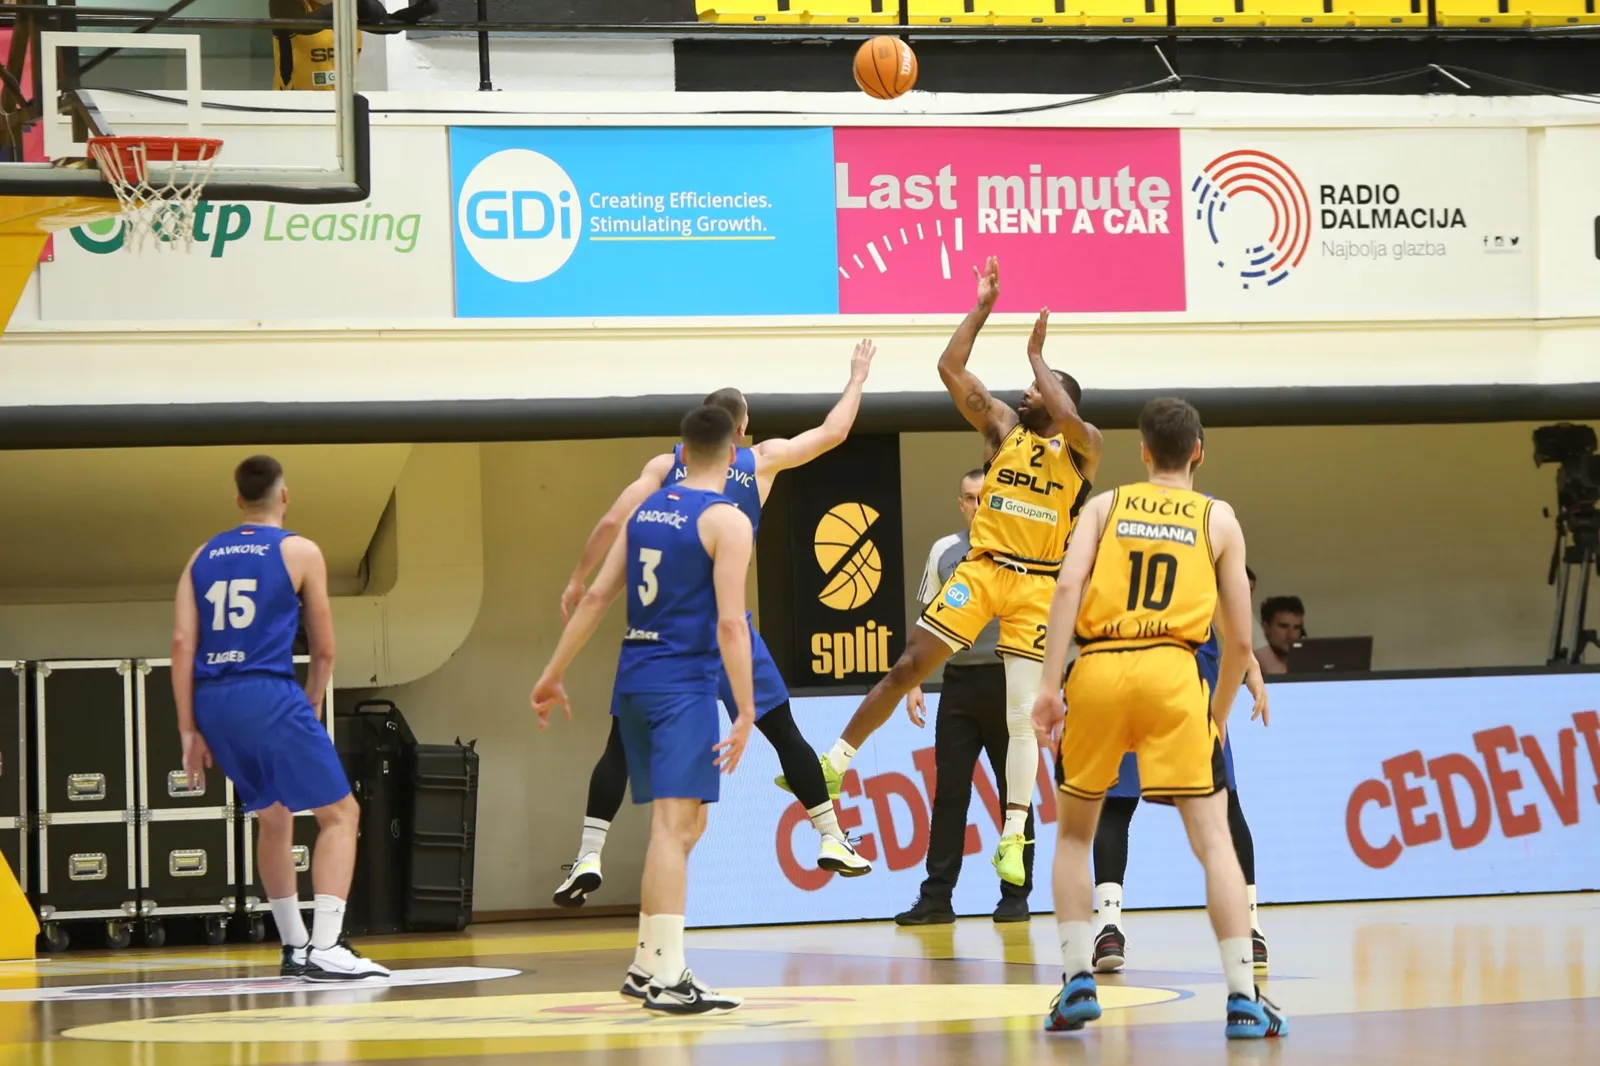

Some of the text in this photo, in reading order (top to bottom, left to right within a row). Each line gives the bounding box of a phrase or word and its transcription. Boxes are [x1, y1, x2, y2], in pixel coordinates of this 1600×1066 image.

[835, 162, 1171, 211] Last minute
[1320, 184, 1400, 205] RADIO
[589, 191, 773, 213] Creating Efficiencies.
[466, 190, 572, 240] GDi
[590, 215, 768, 236] Stimulating Growth.
[977, 208, 1170, 234] RENT A CAR
[1320, 208, 1467, 229] DALMACIJA
[264, 202, 421, 254] Leasing
[1322, 239, 1447, 260] Najbolja glazba
[1030, 445, 1045, 468] 2
[1004, 500, 1057, 522] Groupama
[1125, 496, 1197, 519] KUČIĆ
[1117, 521, 1195, 545] GERMANIA
[208, 543, 270, 560] PAVKOVIĆ
[637, 547, 663, 608] 3
[1126, 550, 1178, 613] 10
[204, 578, 258, 631] 15
[811, 619, 893, 680] split
[1032, 624, 1048, 651] 2
